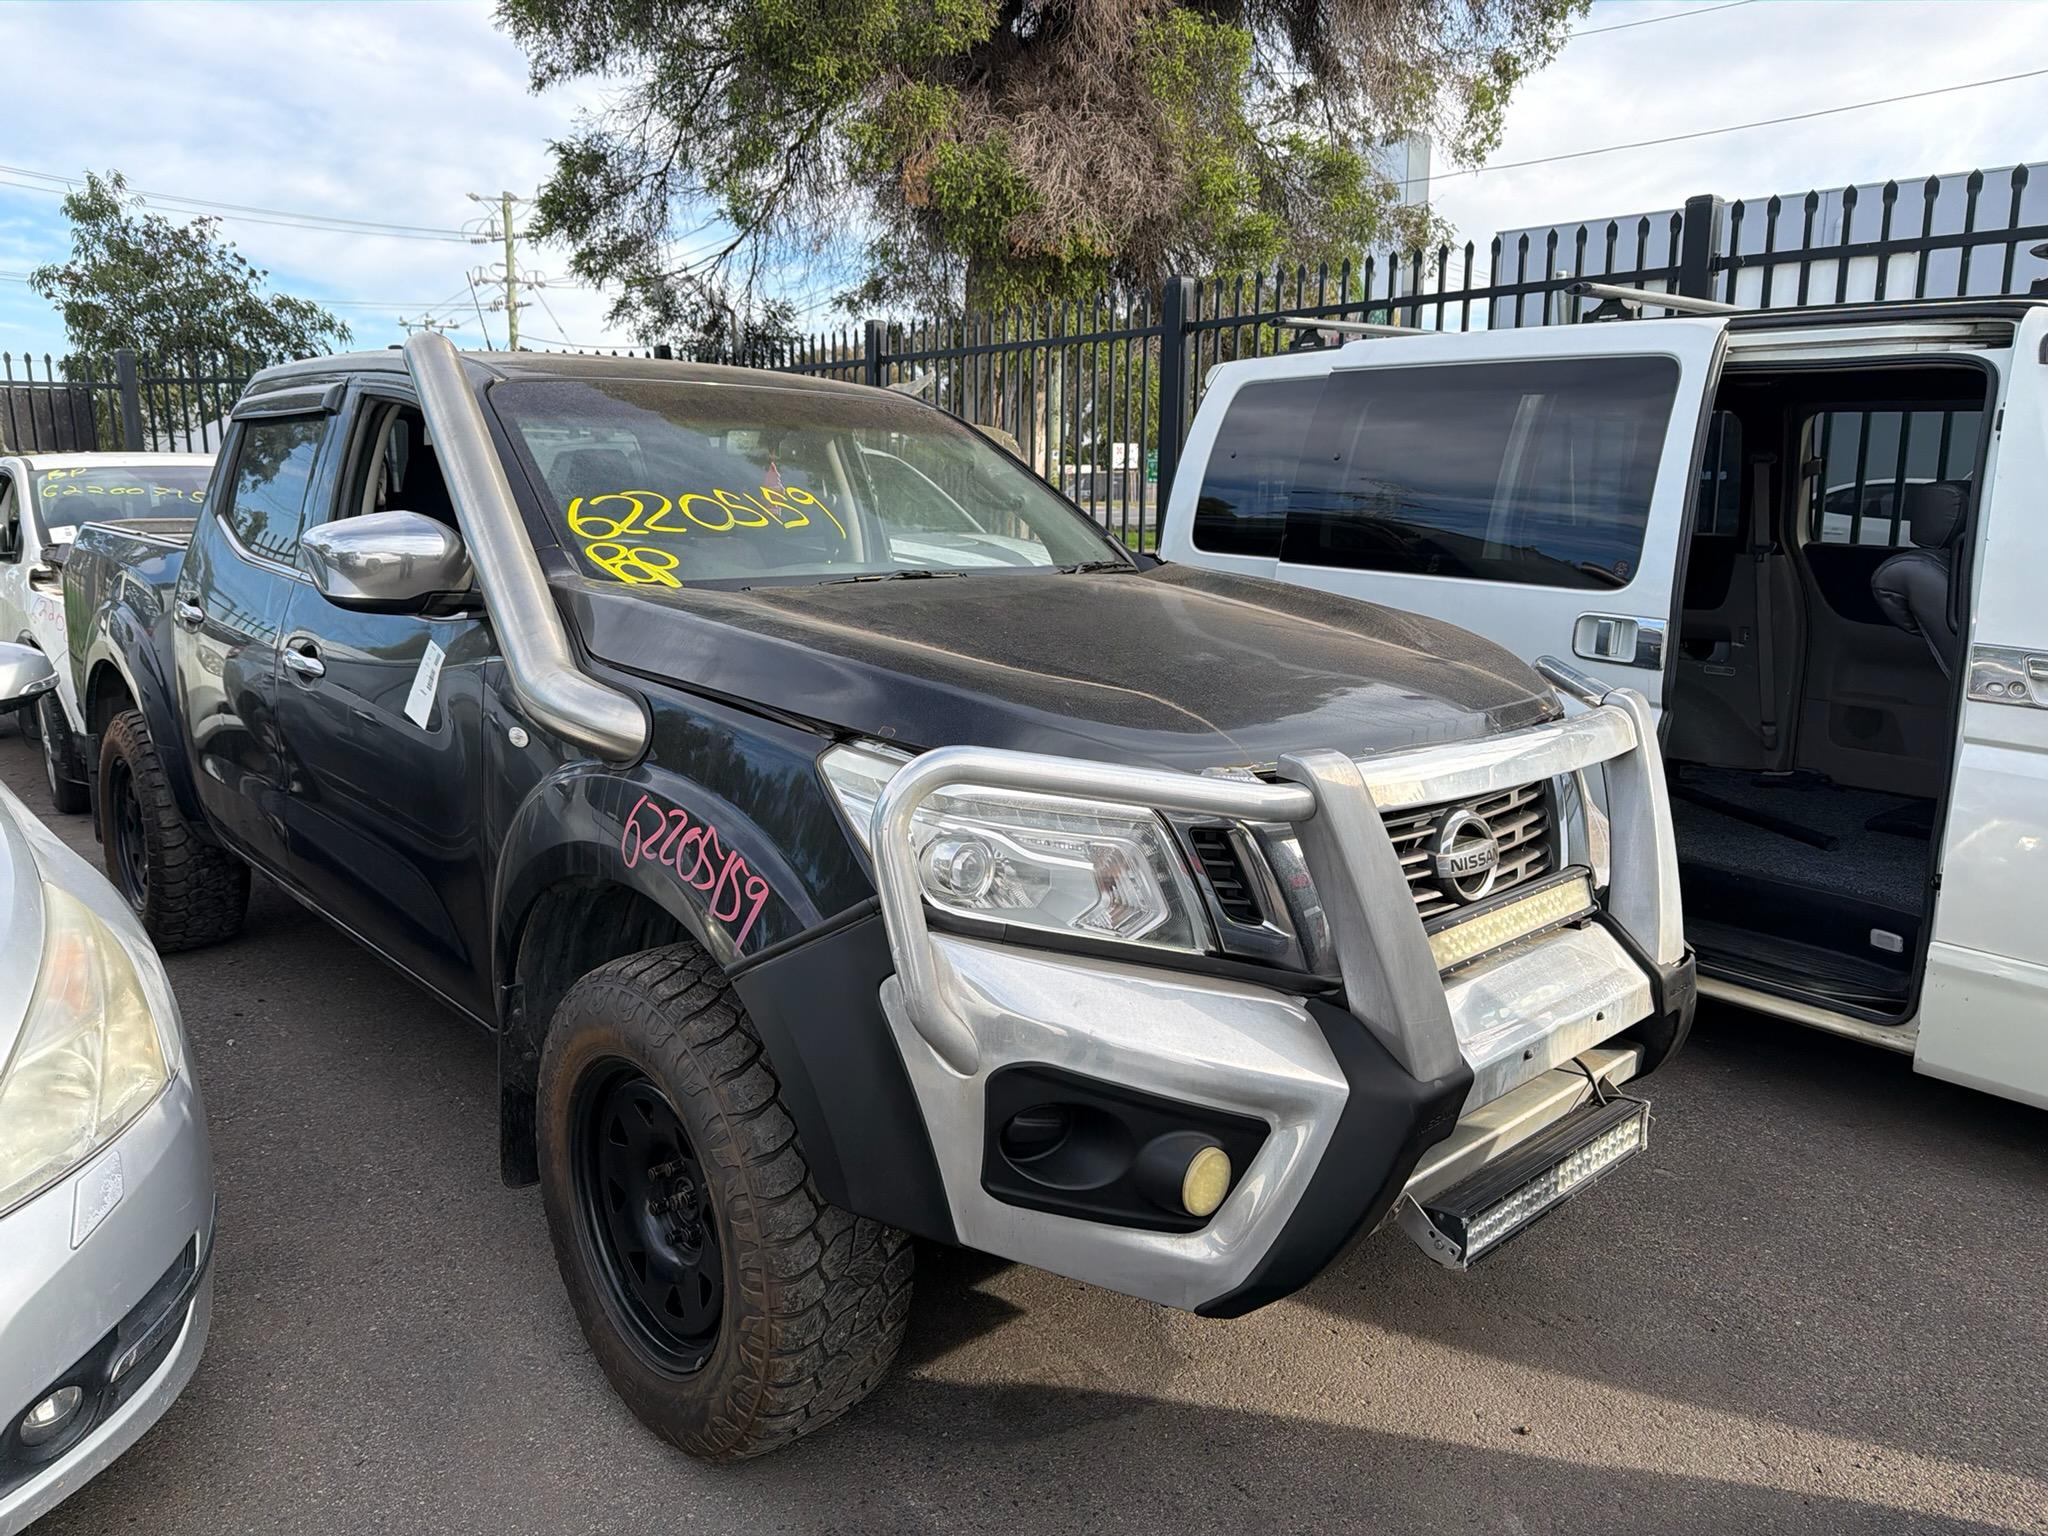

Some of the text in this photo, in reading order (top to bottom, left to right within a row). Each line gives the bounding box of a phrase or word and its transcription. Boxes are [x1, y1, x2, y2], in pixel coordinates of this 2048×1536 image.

[567, 486, 847, 540] 62205159
[621, 794, 769, 953] 62205159
[1450, 848, 1498, 872] NISSAN
